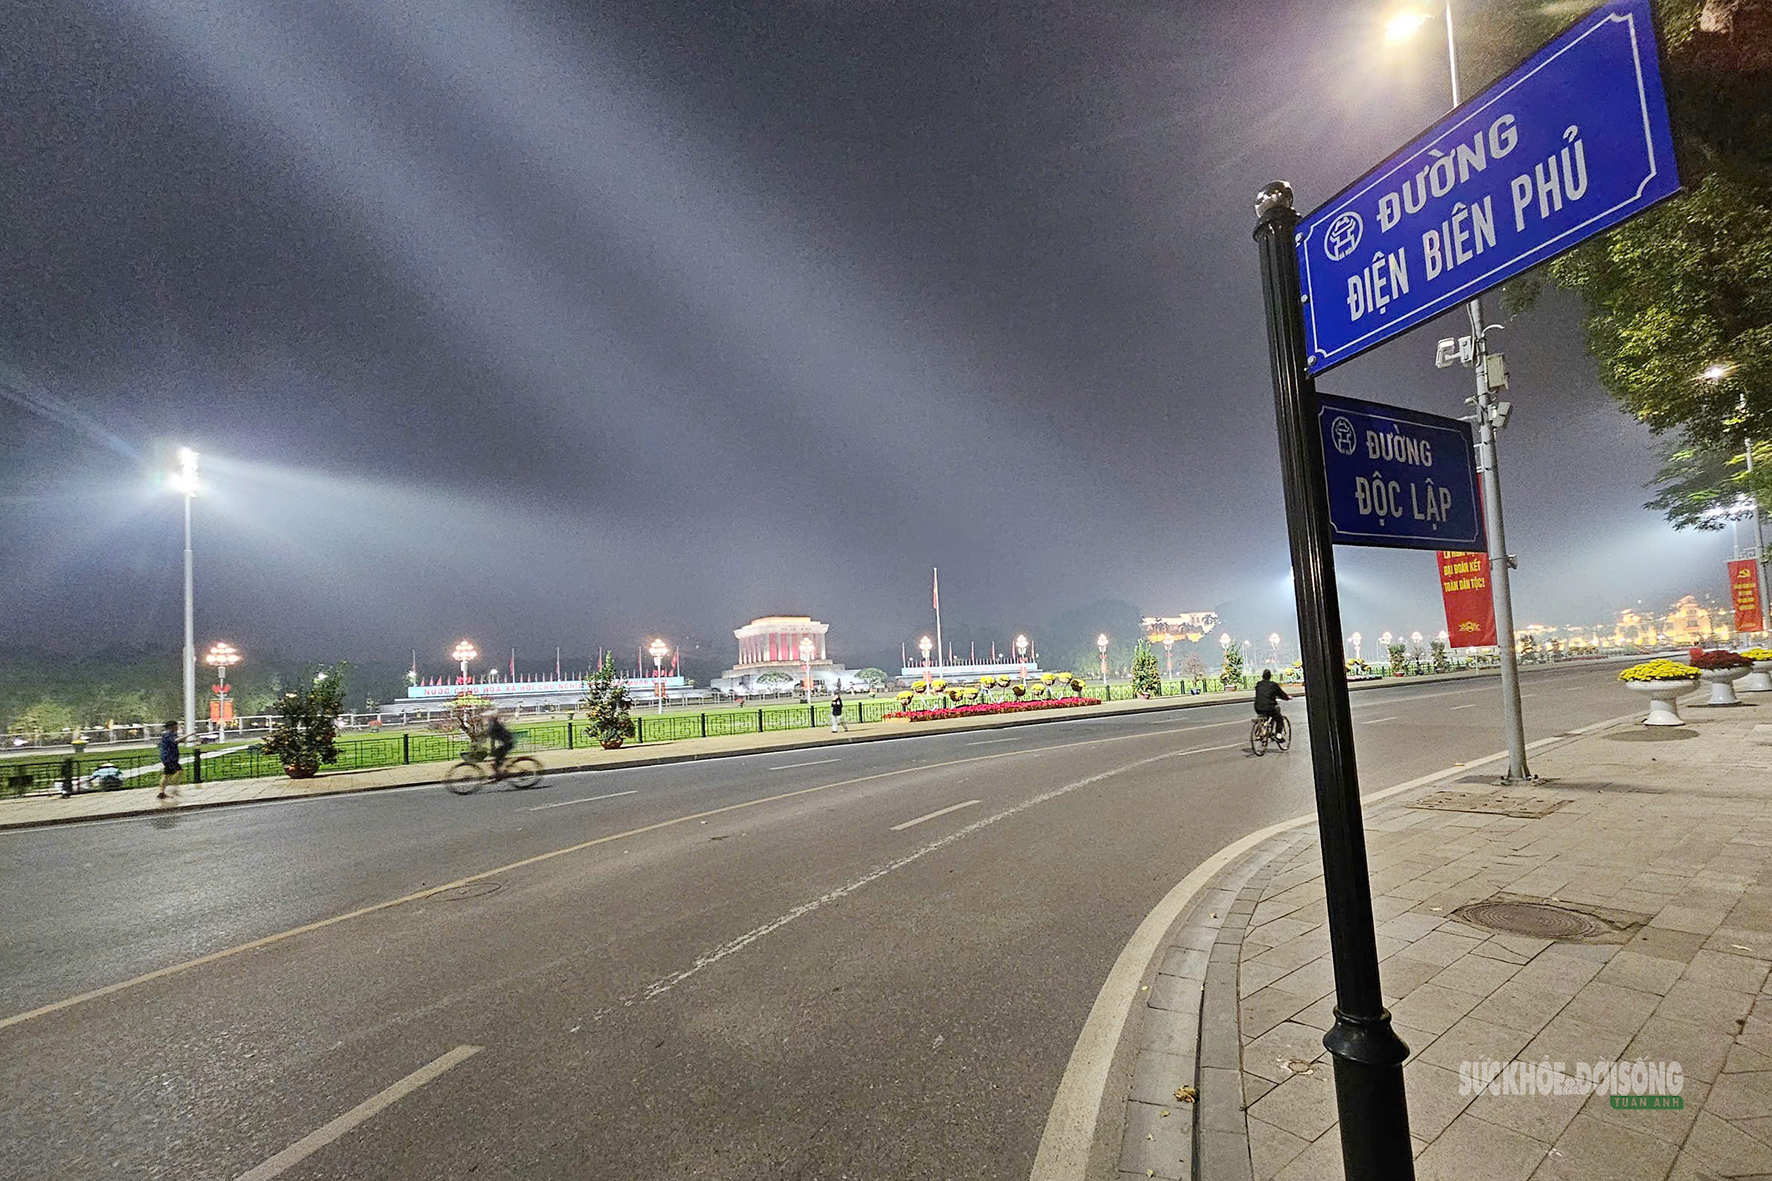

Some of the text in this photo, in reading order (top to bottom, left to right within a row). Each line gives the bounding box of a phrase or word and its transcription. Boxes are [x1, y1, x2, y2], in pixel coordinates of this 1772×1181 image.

[1377, 113, 1518, 233] ĐƯỜNG
[1346, 125, 1588, 322] ĐIỆN BIÊN PHỦ
[1366, 423, 1433, 467] ĐƯỜNG
[1355, 471, 1452, 530] ĐỘC LẬP
[1469, 558, 1481, 572] KẾT
